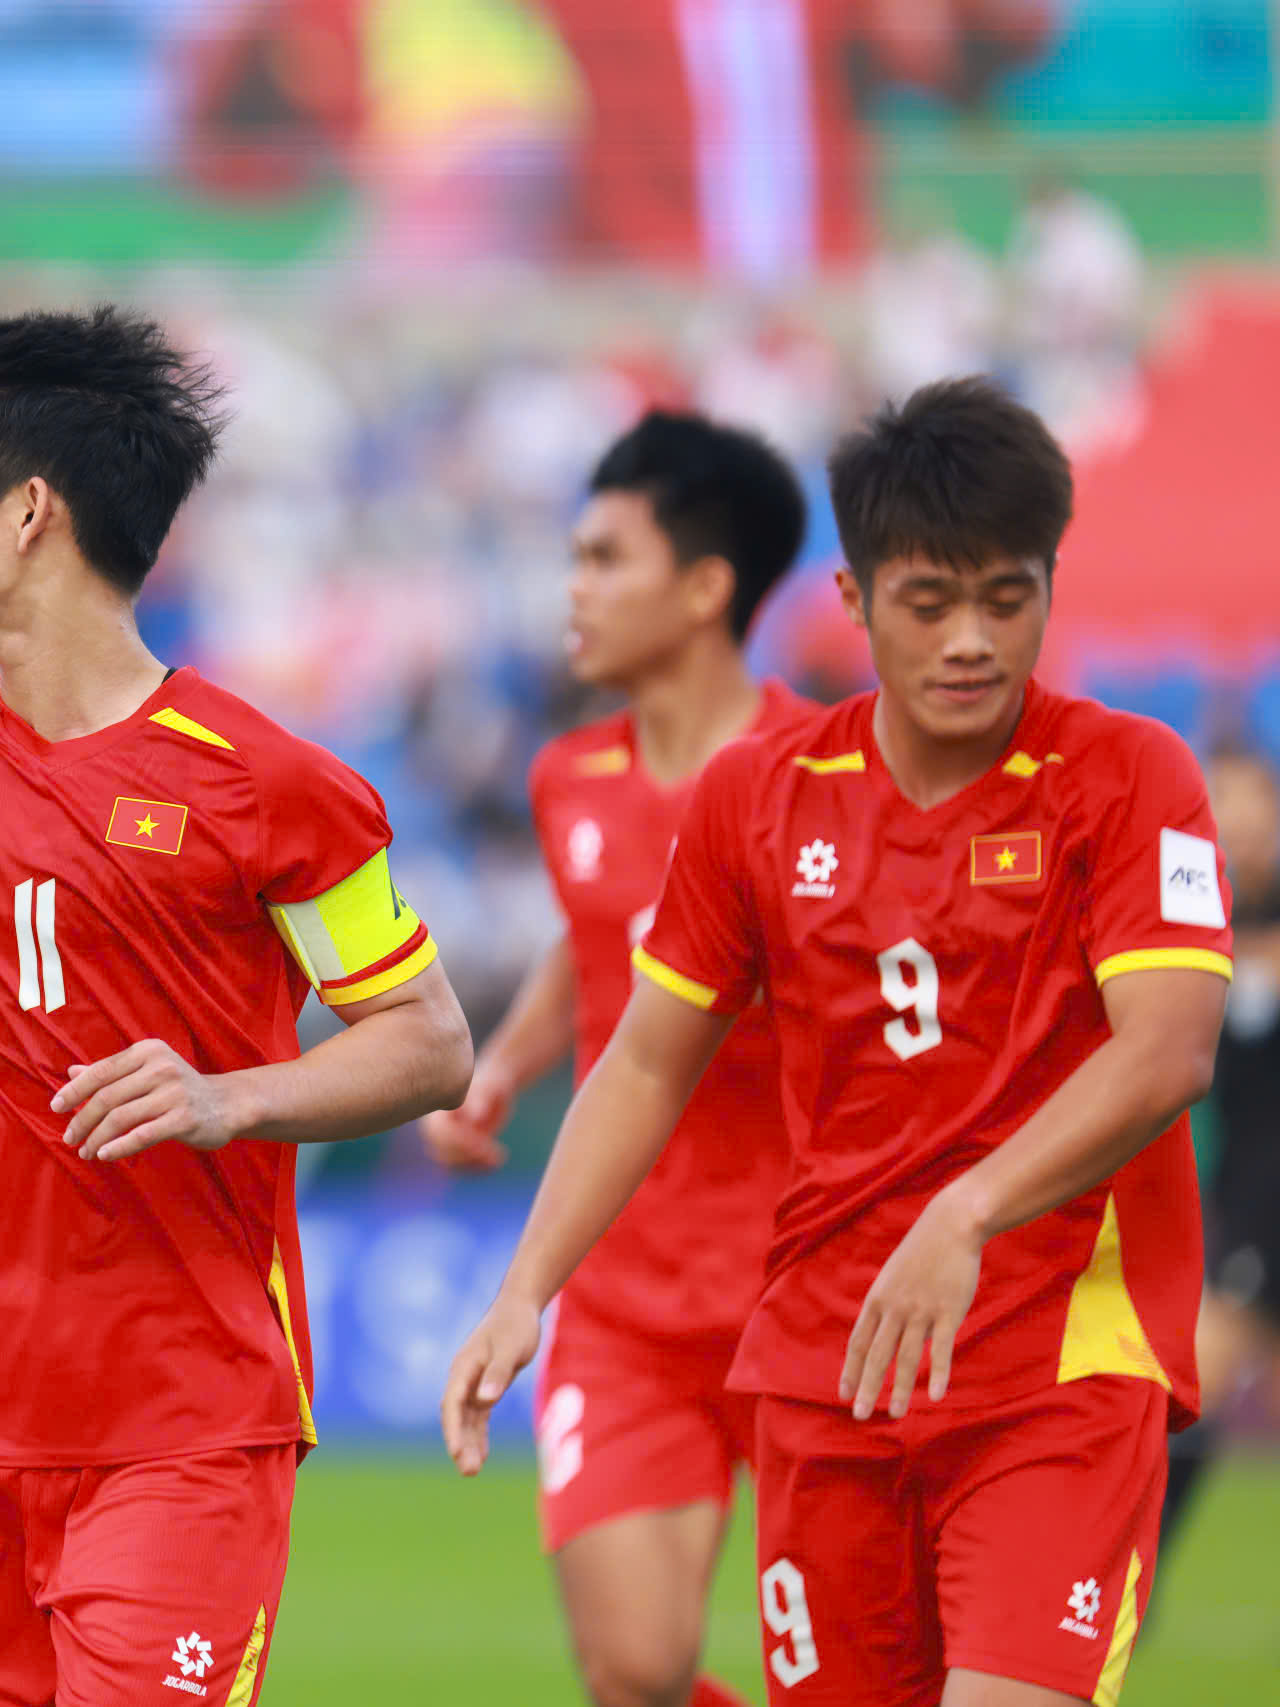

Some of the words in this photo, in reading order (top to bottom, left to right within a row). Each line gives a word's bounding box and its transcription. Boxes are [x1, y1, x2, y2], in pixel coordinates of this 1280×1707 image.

[15, 877, 66, 1015] 11
[877, 937, 942, 1062] 9
[162, 1674, 207, 1696] JOGARBOLA
[762, 1556, 820, 1688] 9
